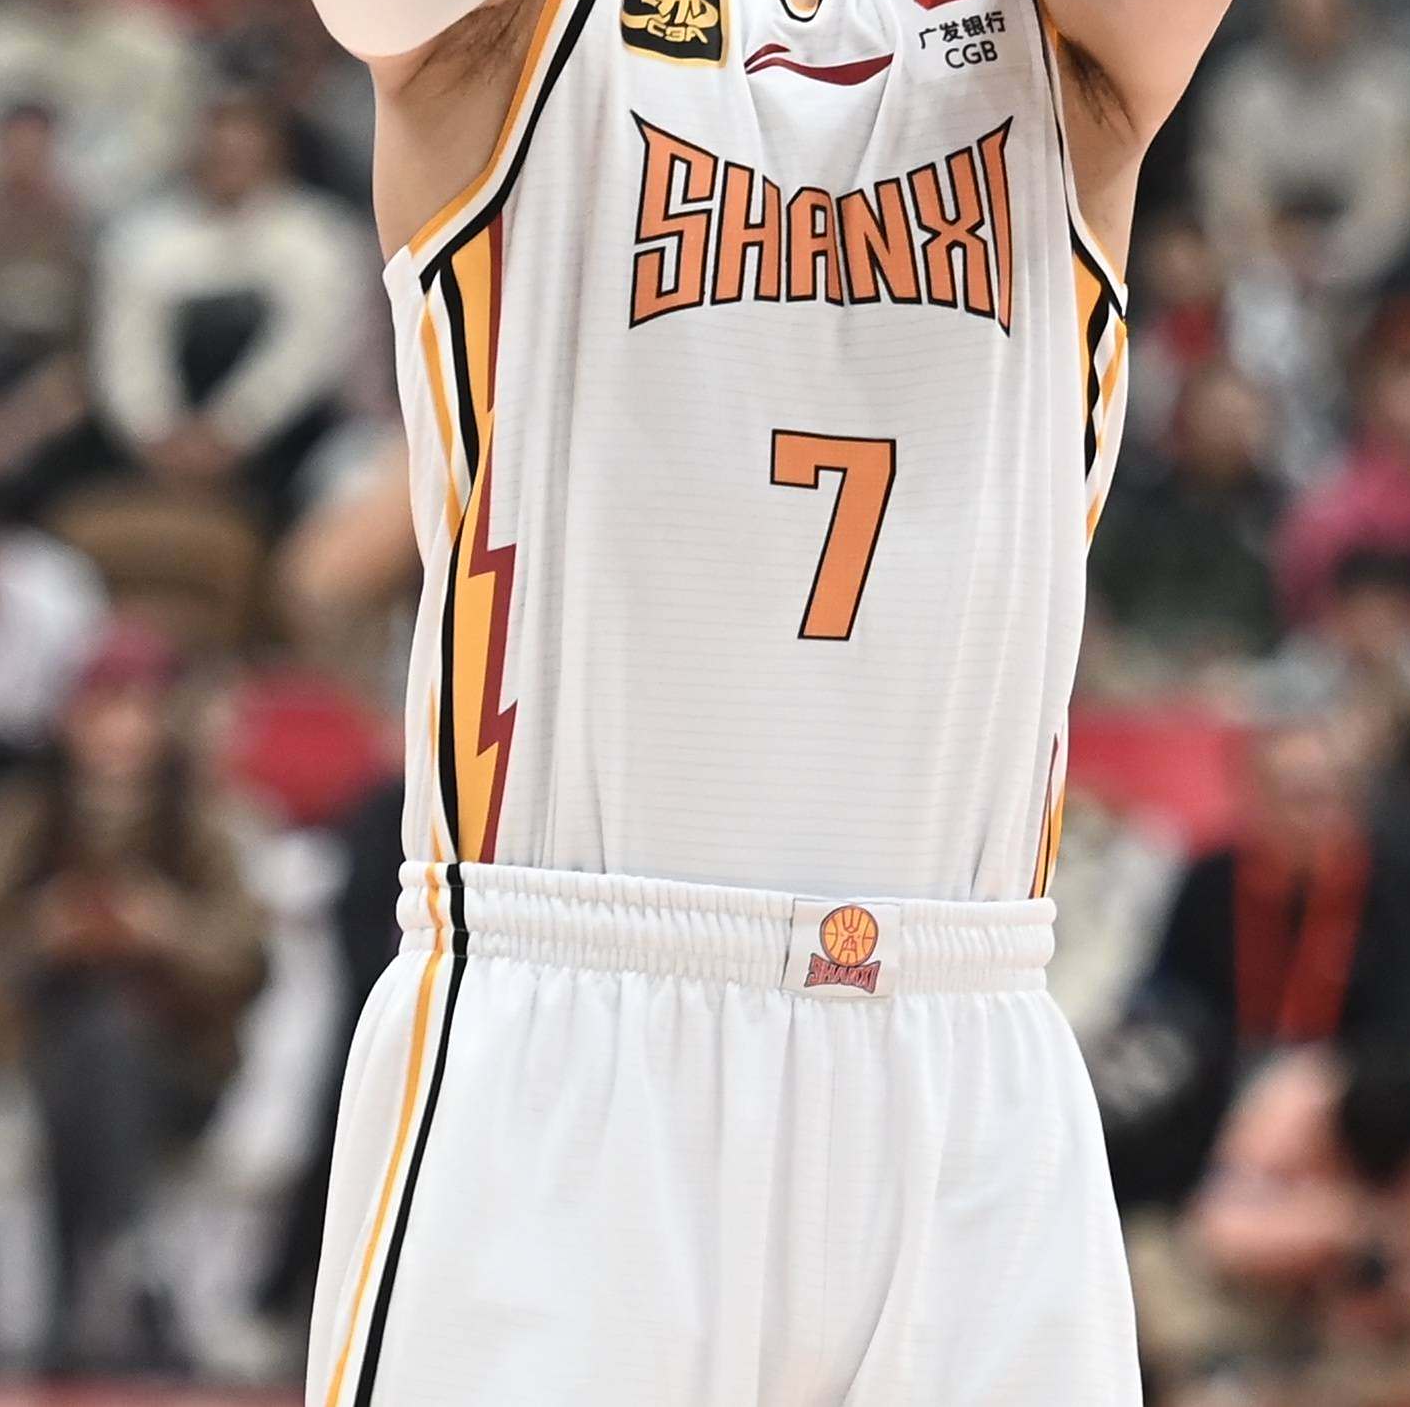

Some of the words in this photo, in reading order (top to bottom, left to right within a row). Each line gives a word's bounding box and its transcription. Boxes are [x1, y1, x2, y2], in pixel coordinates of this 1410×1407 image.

[918, 10, 1006, 49] 广发银行
[944, 40, 998, 69] CGB
[629, 109, 1014, 338] SHANXI
[769, 428, 897, 642] 7
[803, 952, 881, 994] SHANXI
